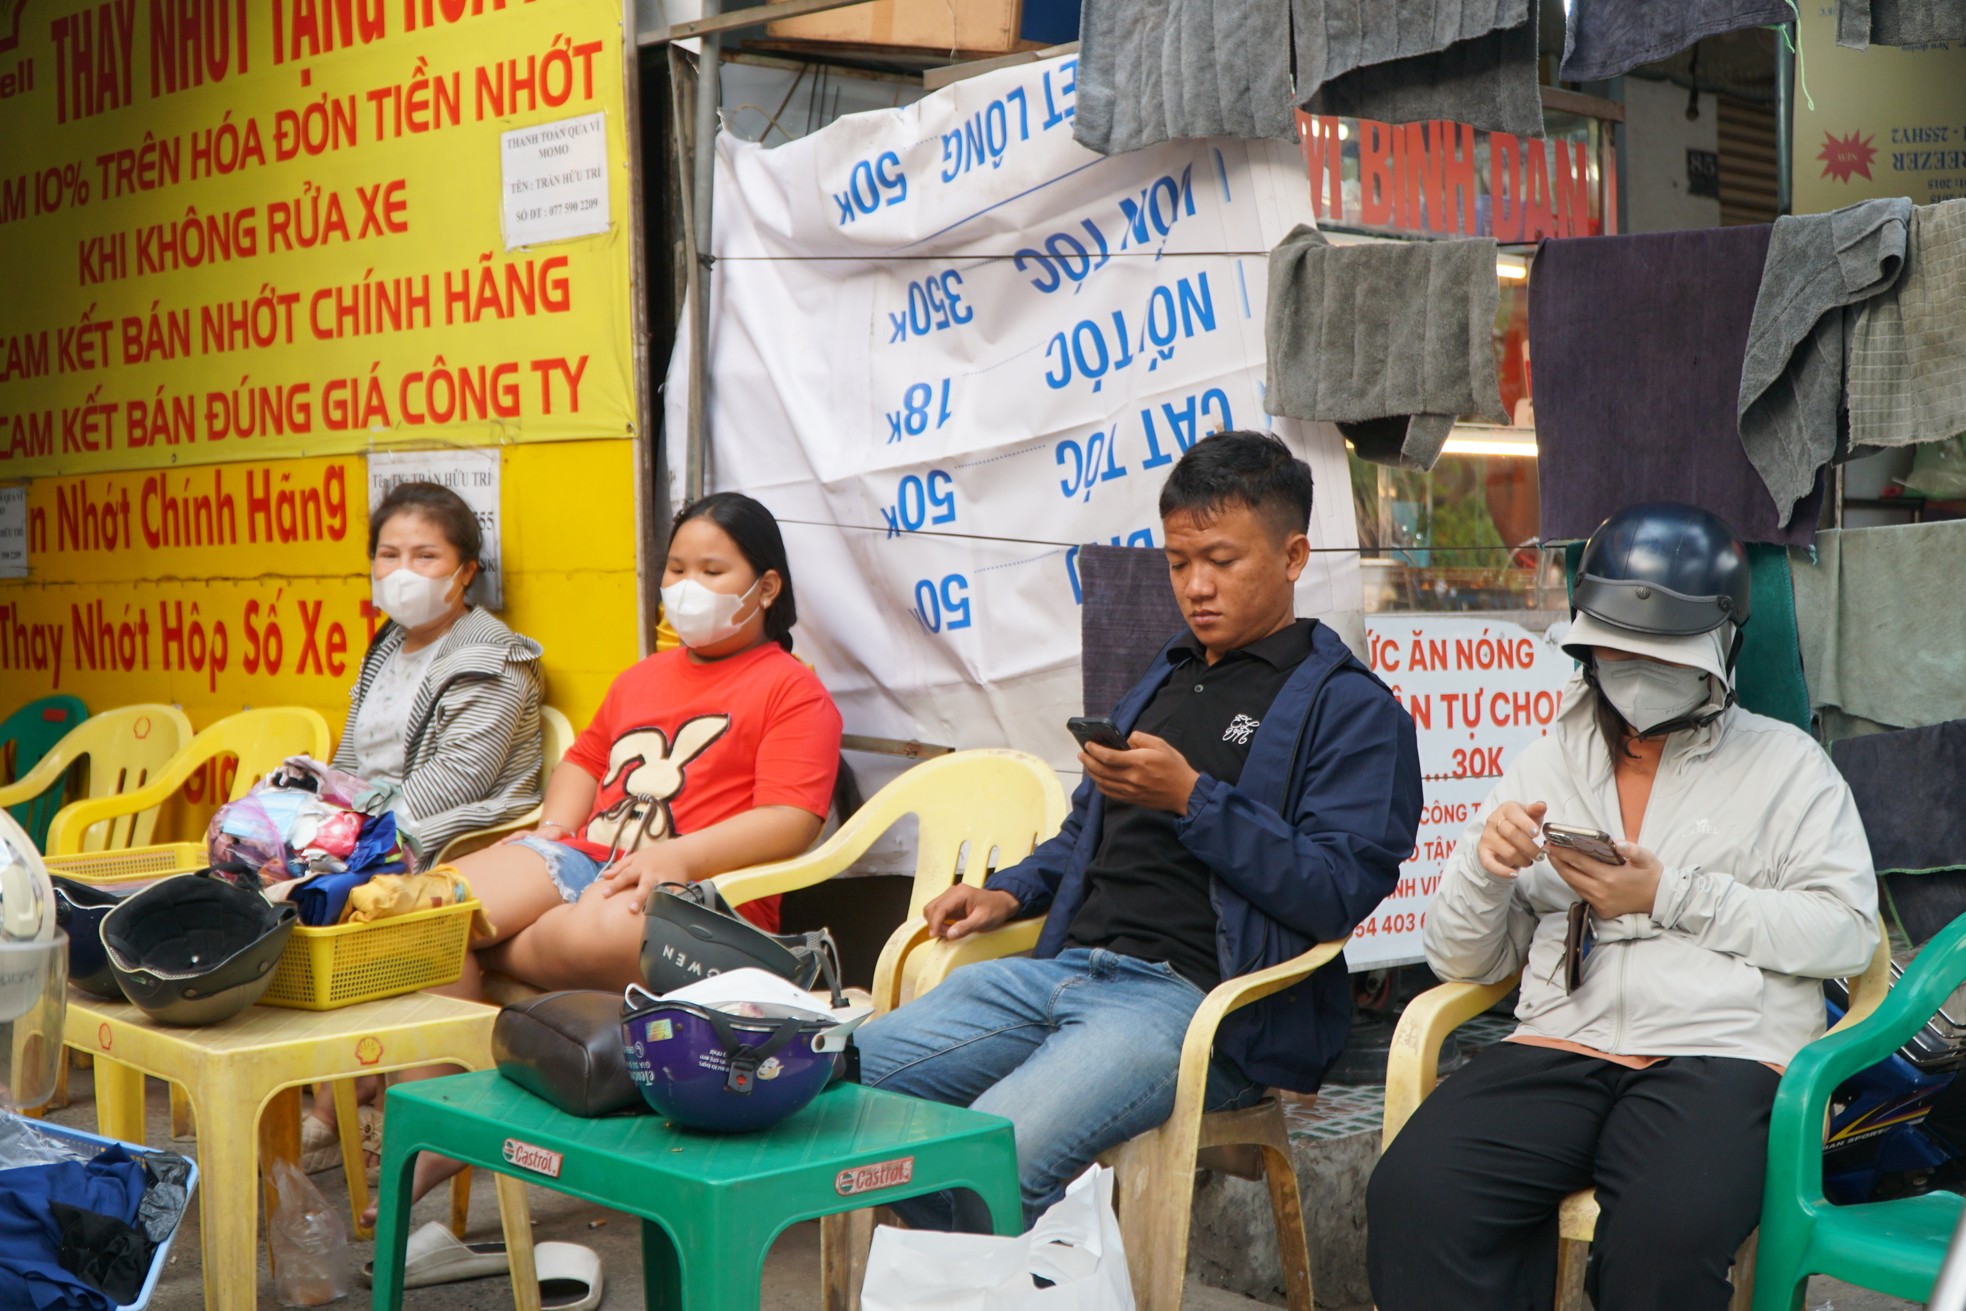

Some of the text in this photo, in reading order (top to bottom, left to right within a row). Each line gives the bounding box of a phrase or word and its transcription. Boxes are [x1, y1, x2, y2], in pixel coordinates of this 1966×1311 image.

[96, 131, 180, 200] TRÊN
[190, 109, 266, 181] HÓA
[273, 92, 357, 163] ĐƠN
[366, 56, 461, 142] TIỀN
[475, 32, 603, 122] NHỚT
[507, 134, 539, 150] THANH
[567, 123, 588, 139] QUA
[941, 85, 1030, 184] LÔNG
[539, 144, 569, 159] MOMO
[79, 178, 408, 286] KHI KHÔNG RỬA XE
[57, 302, 114, 374] KẾT
[122, 299, 191, 366] BÁN
[201, 282, 300, 355] NHỚT
[309, 267, 431, 340] CHÍNH
[443, 250, 571, 326] HÃNG
[62, 383, 119, 454] KẾT
[126, 384, 196, 449] BÁN
[204, 374, 311, 442] ĐÚNG
[321, 360, 391, 432] GIÁ
[399, 354, 521, 426] CÔNG
[530, 355, 589, 415] TY
[472, 467, 492, 487] TRÍ
[1055, 422, 1128, 503] TÓC
[56, 479, 130, 552] Nhớt
[140, 468, 237, 551] Chính
[246, 463, 348, 544] Hãng
[0, 602, 63, 690] Thay
[71, 598, 149, 673] Nhớt
[243, 587, 283, 676] Số
[295, 600, 348, 677] Xe
[1408, 629, 1448, 672] ĂN
[1456, 628, 1534, 672] NÓNG
[1440, 687, 1484, 740] TỰ
[1490, 690, 1563, 737] CHỌ
[1382, 912, 1416, 935] 403
[515, 1145, 553, 1173] Castrol
[855, 1162, 905, 1190] Castrol
